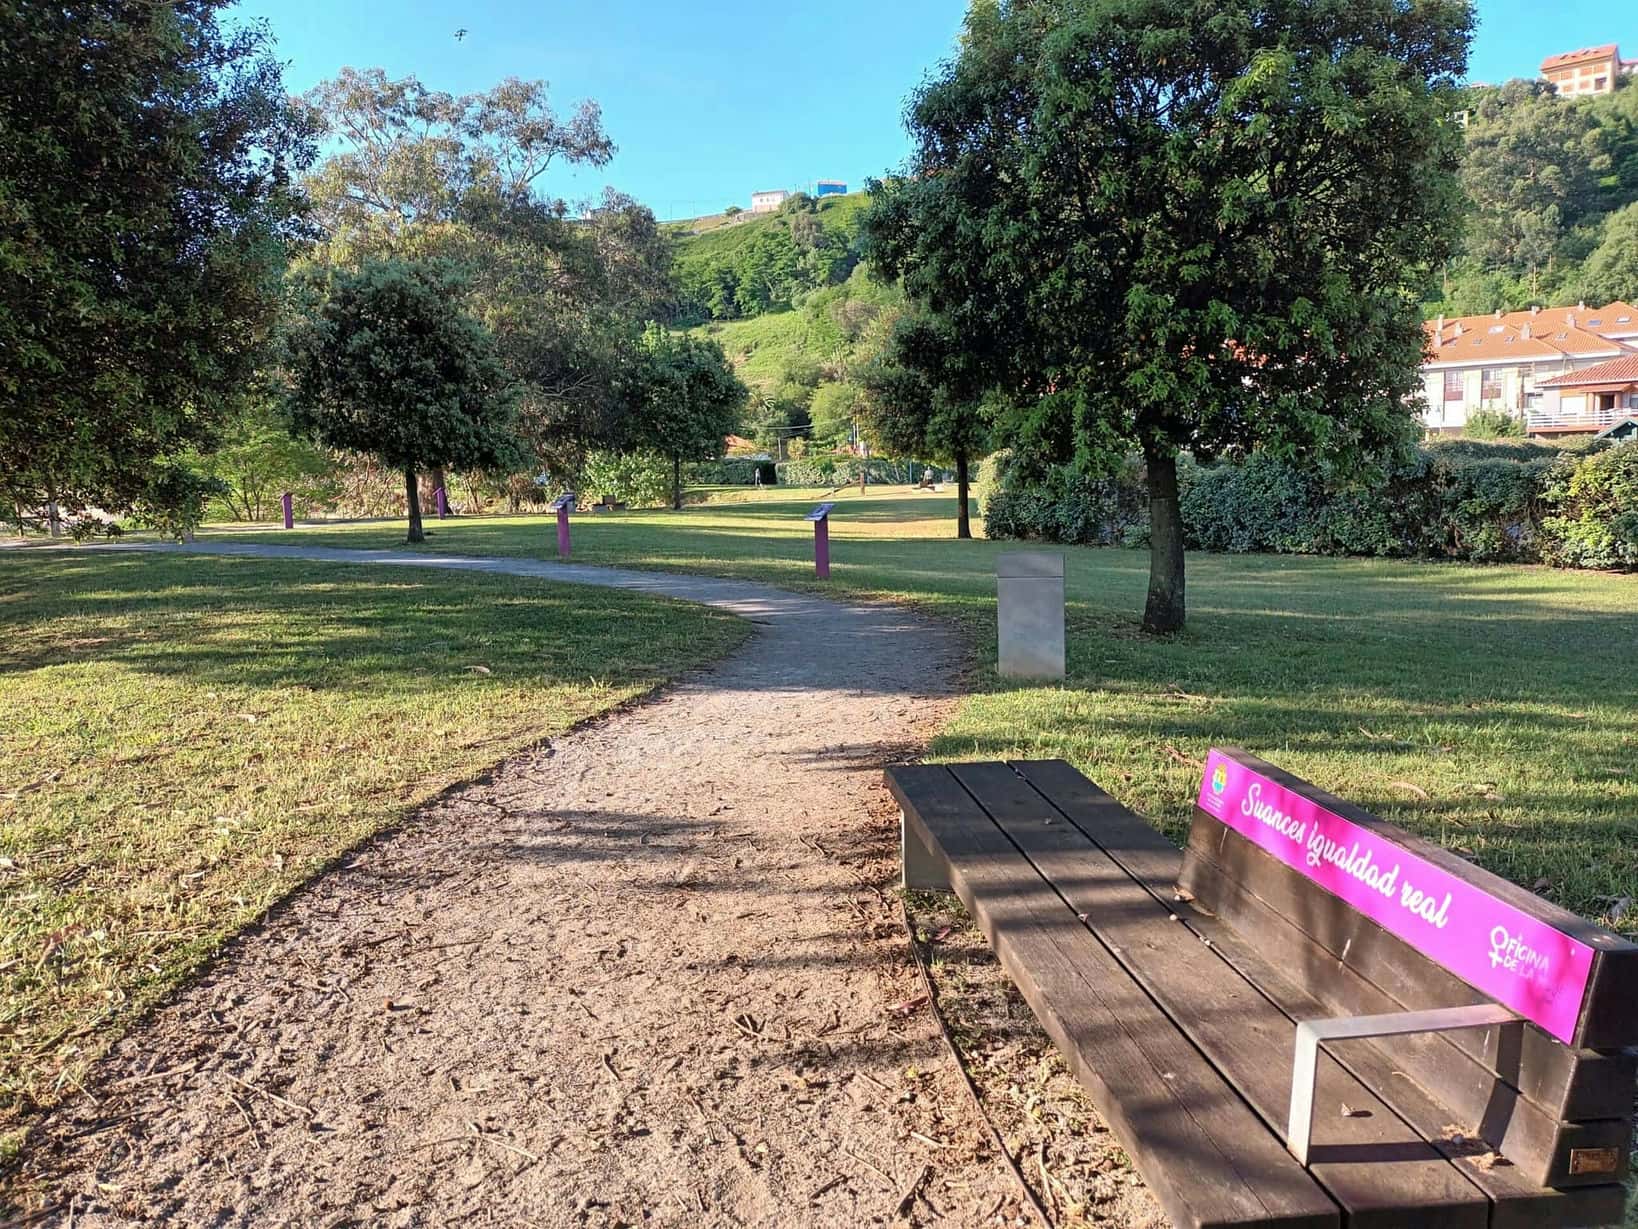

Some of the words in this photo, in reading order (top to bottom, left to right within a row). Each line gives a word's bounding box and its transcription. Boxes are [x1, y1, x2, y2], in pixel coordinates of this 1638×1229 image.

[1241, 783, 1305, 844] Suances
[1401, 881, 1453, 929] real
[1503, 955, 1520, 973] DE
